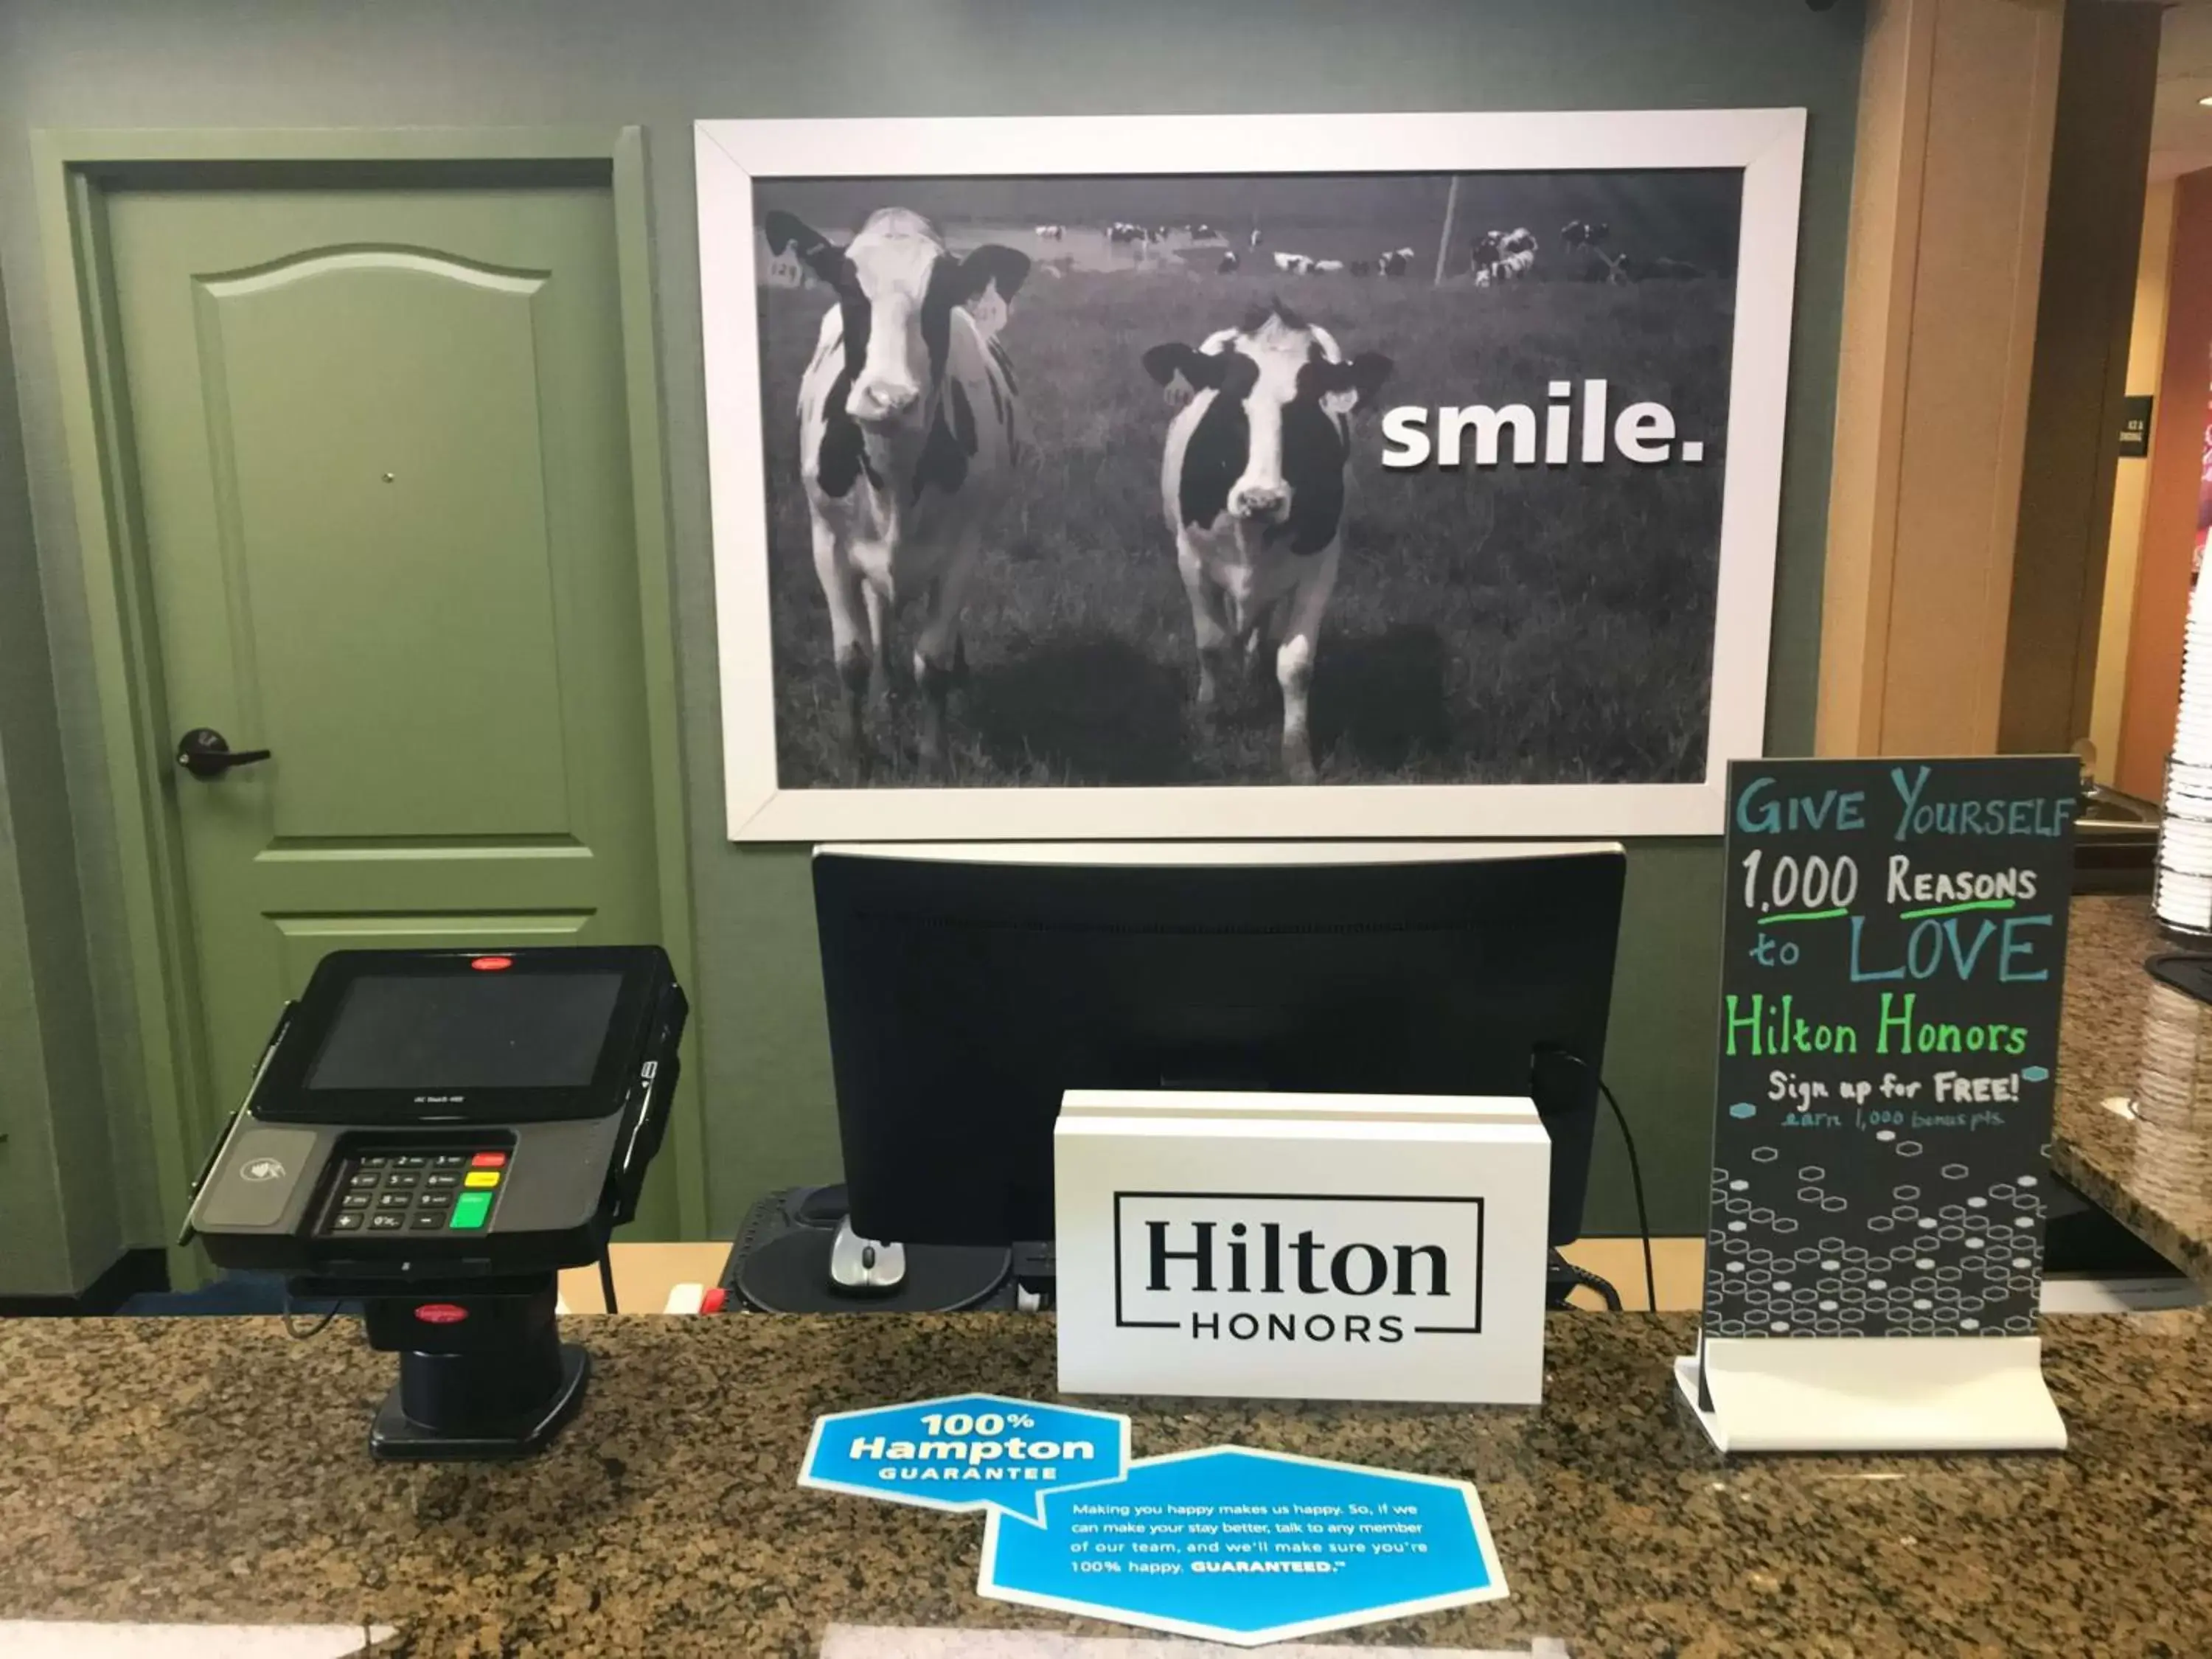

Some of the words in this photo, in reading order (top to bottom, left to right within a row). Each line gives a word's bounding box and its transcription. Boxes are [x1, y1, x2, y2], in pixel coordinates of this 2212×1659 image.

[1381, 379, 1703, 467] smile.
[1749, 933, 1800, 967] to
[1850, 914, 2053, 982] LOVE
[1725, 994, 1857, 1056] Hilton
[1876, 992, 2028, 1055] Honors
[1767, 1070, 1829, 1112] Sign
[1840, 1080, 1872, 1105] up
[1879, 1072, 1921, 1099] for
[1933, 1071, 2020, 1103] FREE!
[1781, 1112, 1841, 1127] earn
[1911, 1111, 1966, 1128] bonus
[1145, 1221, 1451, 1296] Hilton
[1192, 1312, 1404, 1343] HONORS
[921, 1413, 1035, 1436] 100%
[849, 1436, 1094, 1466] Hampton
[878, 1467, 1057, 1481] GUARANTEE
[1073, 1503, 1130, 1517] Making
[1134, 1505, 1162, 1516] you
[1167, 1503, 1214, 1517] happy
[1219, 1503, 1268, 1514] makes
[1273, 1505, 1290, 1515] us
[1349, 1503, 1374, 1516] So,
[1392, 1506, 1418, 1515] we
[1071, 1523, 1099, 1534] can
[1103, 1521, 1145, 1533] make
[1150, 1524, 1184, 1536] your
[1188, 1523, 1219, 1535] stay
[1222, 1521, 1271, 1534] better,
[1275, 1522, 1303, 1534] talk
[1307, 1523, 1324, 1534] to
[1327, 1524, 1355, 1536] any
[1359, 1522, 1424, 1534] member
[1070, 1540, 1089, 1554] of
[1095, 1543, 1125, 1554] our
[1131, 1541, 1181, 1554] team,
[1186, 1541, 1220, 1554] and
[1274, 1540, 1322, 1554] make
[1329, 1543, 1366, 1554] sure
[1071, 1560, 1121, 1573] 100%
